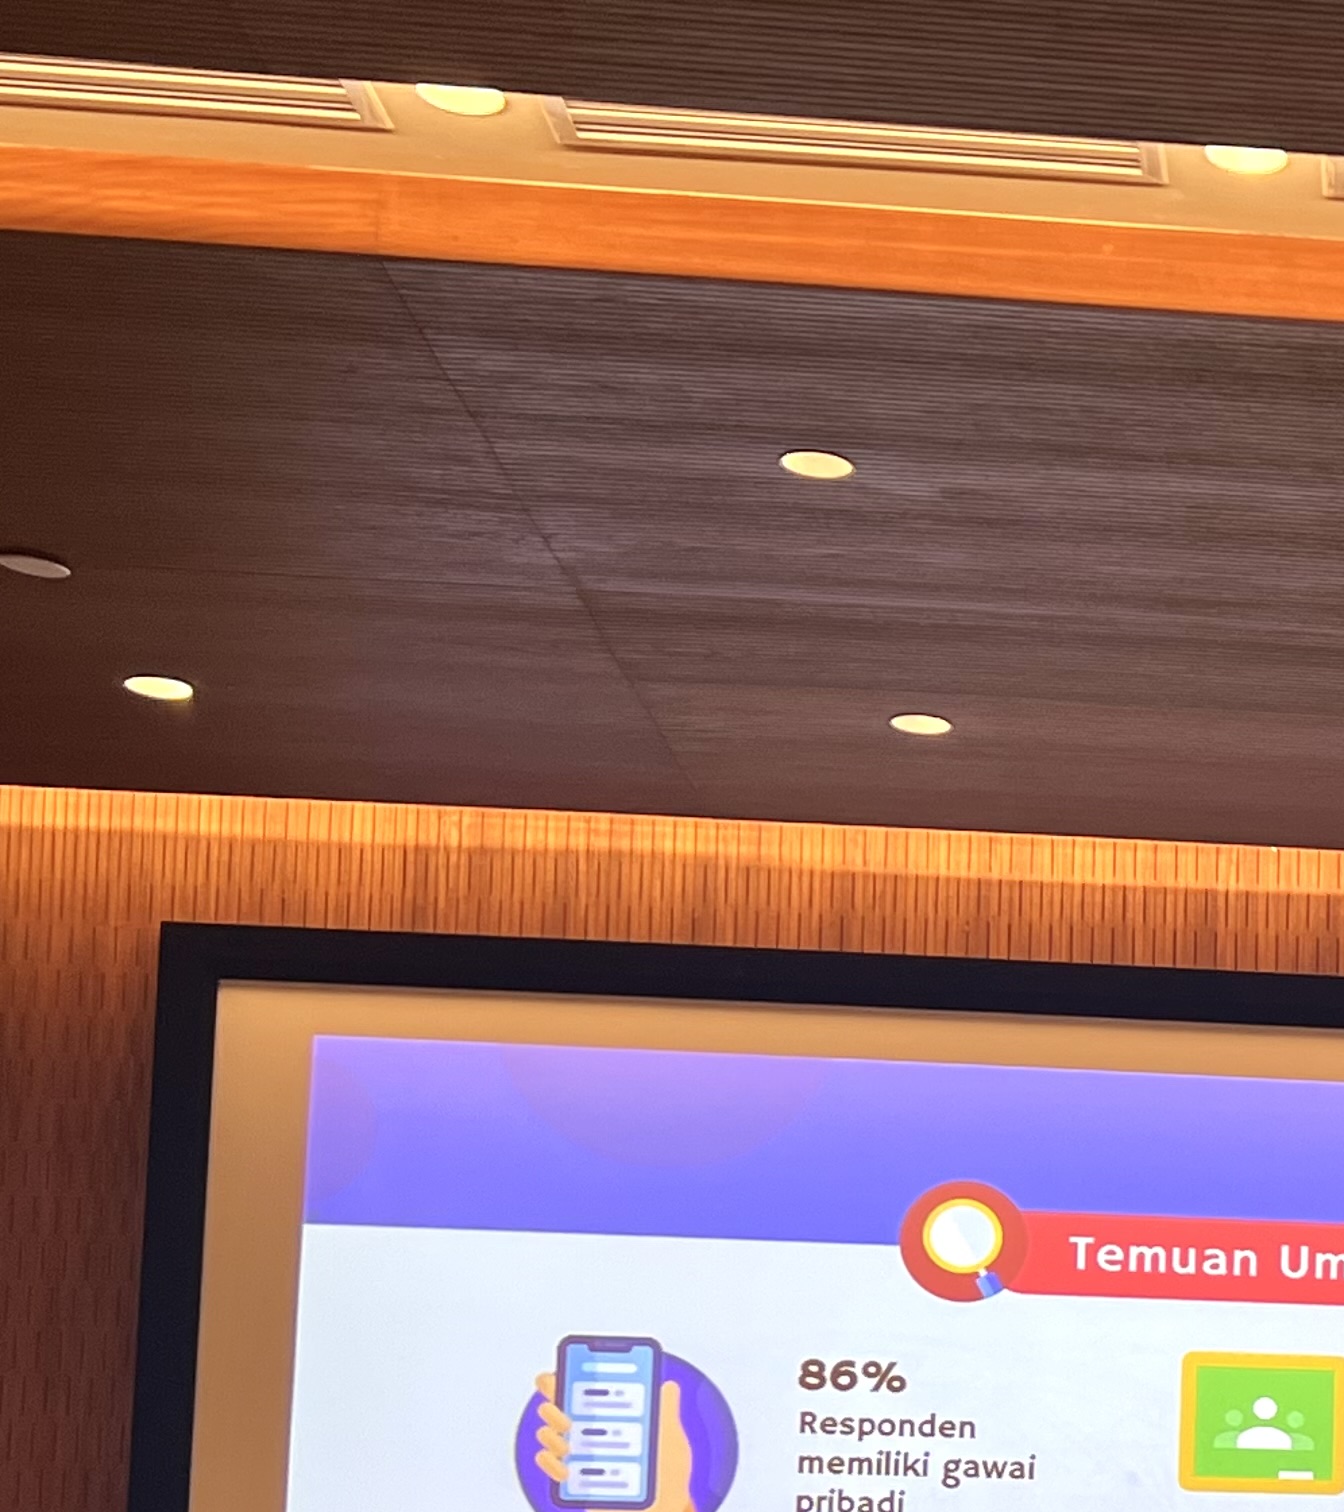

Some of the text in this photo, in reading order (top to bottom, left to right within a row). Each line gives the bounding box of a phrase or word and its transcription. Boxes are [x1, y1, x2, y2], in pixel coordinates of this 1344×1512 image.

[1069, 1237, 1257, 1276] Temuan
[799, 1359, 906, 1392] 86%
[800, 1412, 975, 1441] Responden
[798, 1450, 1035, 1489] memiliki gawai
